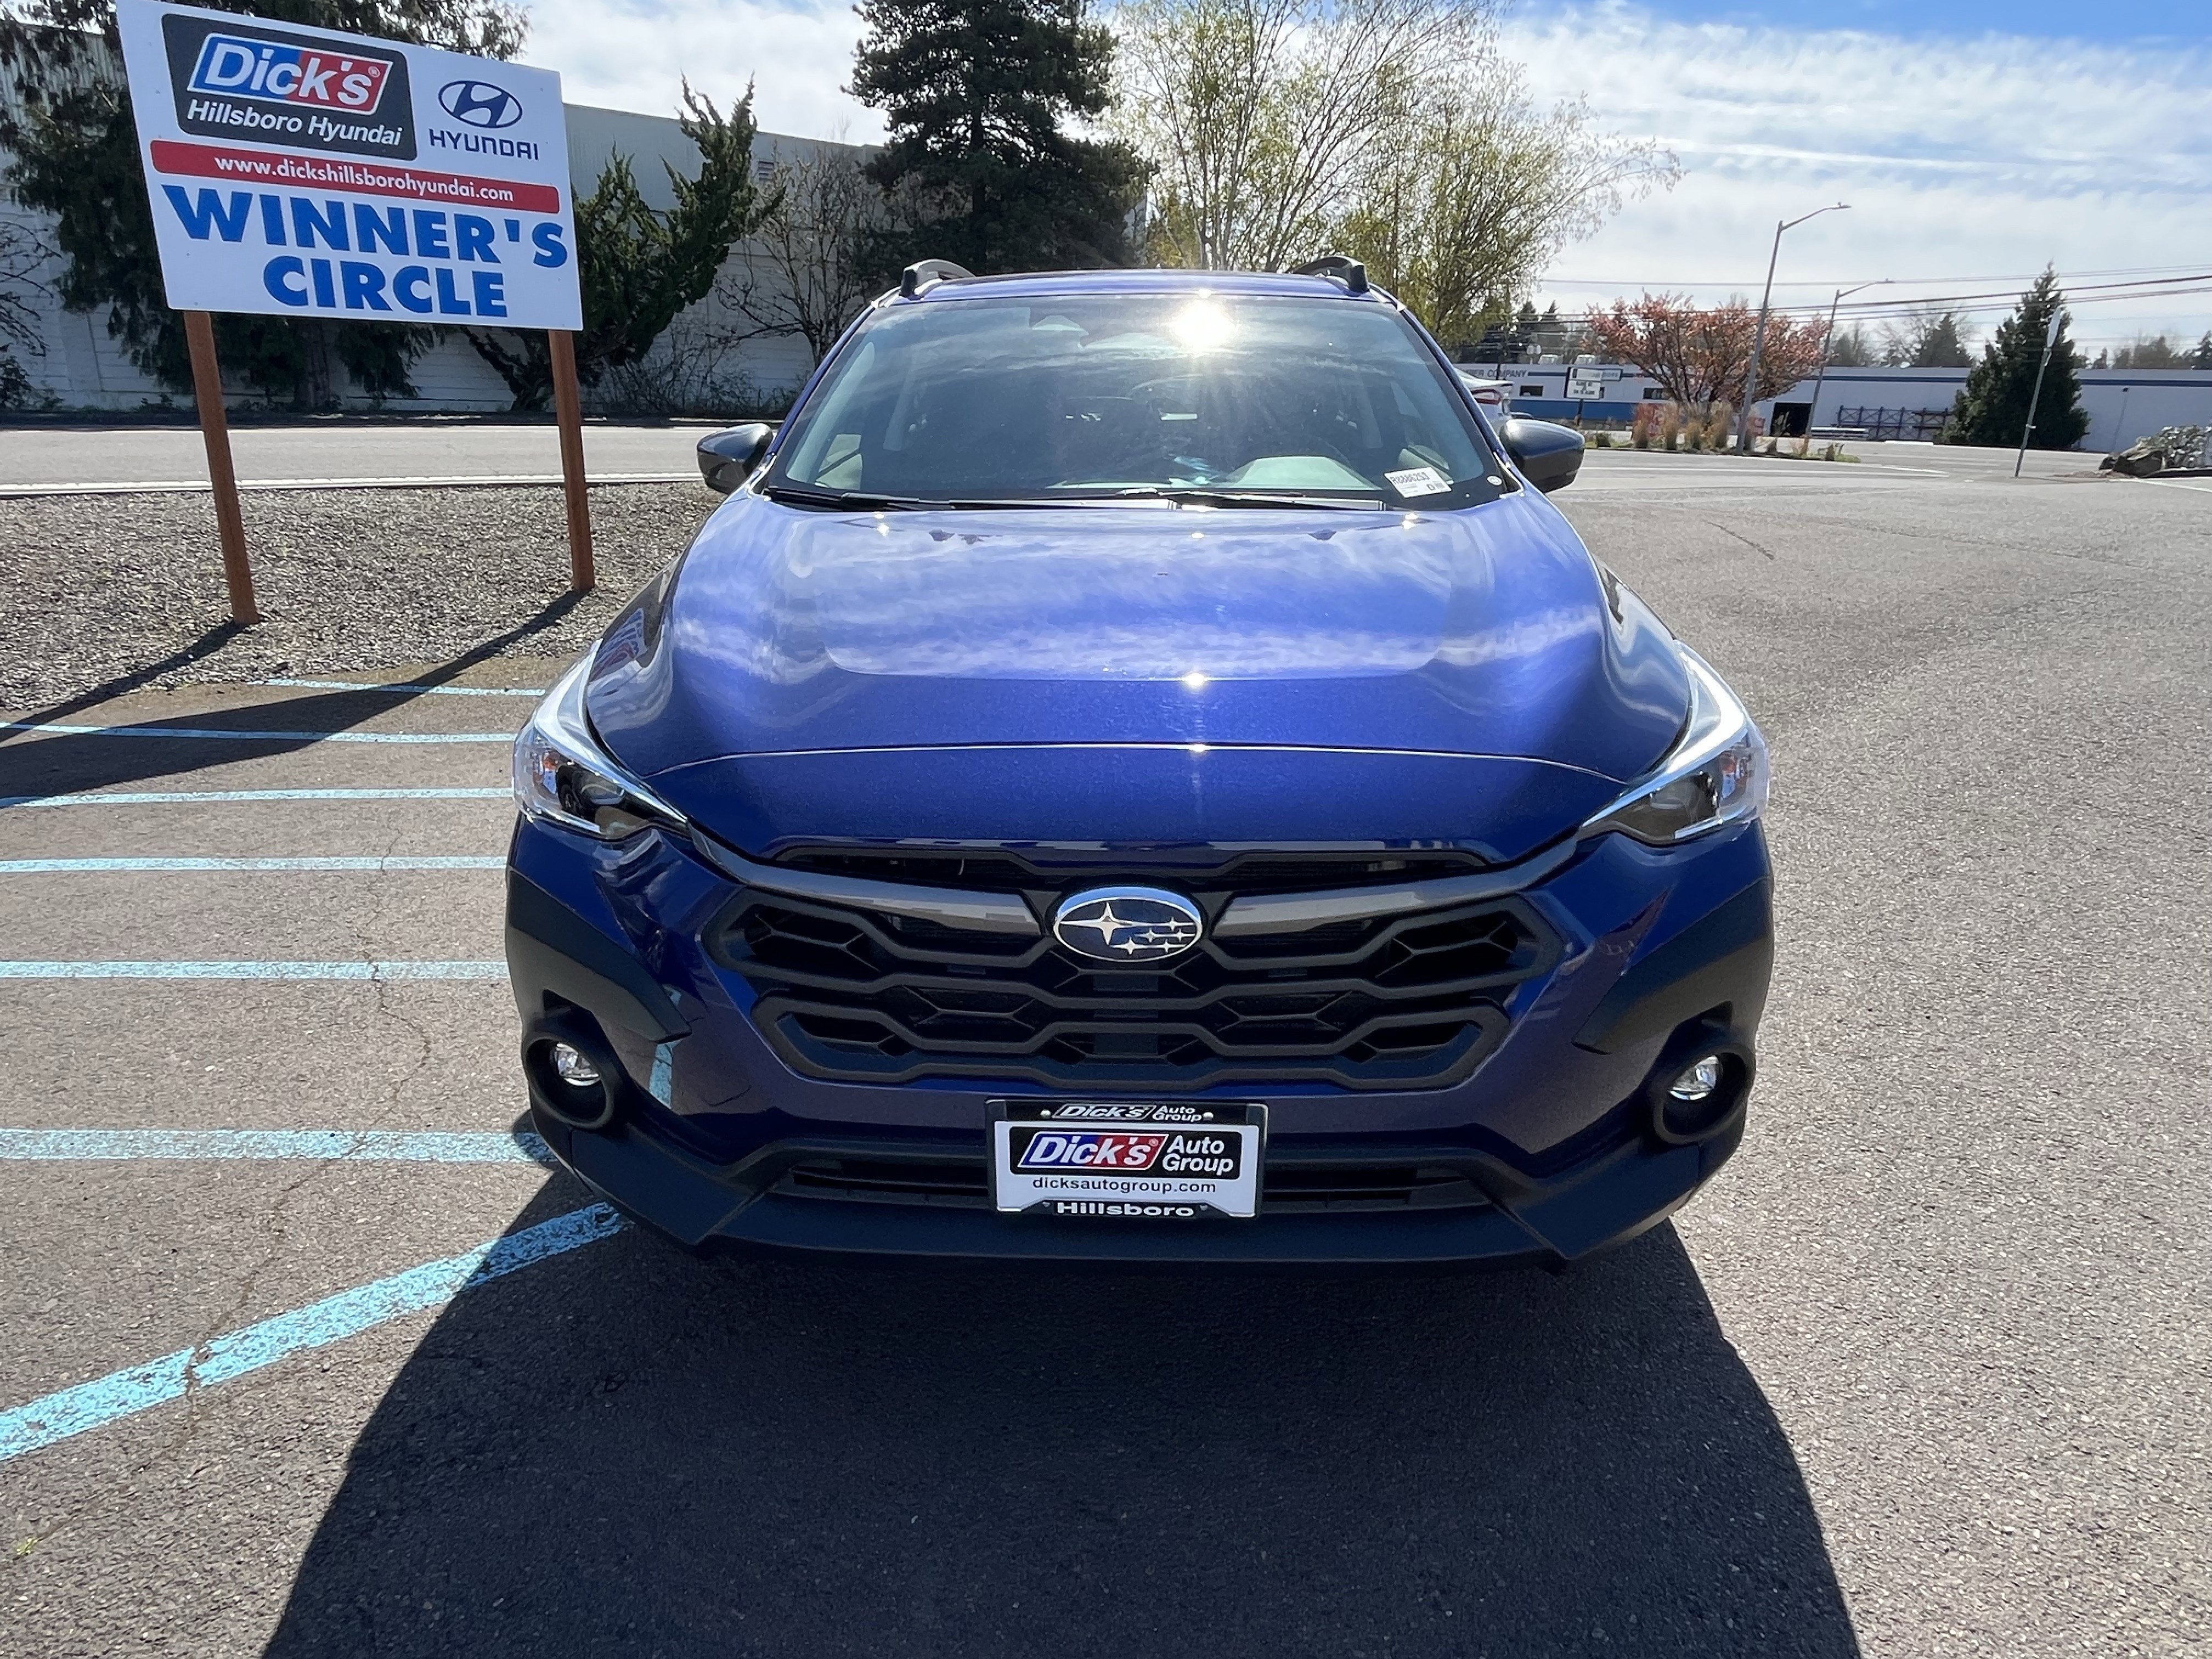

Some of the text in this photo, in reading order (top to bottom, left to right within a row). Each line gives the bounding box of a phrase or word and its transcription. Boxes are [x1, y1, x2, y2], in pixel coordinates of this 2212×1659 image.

[205, 42, 374, 106] Dick's
[187, 98, 404, 147] Hillsboro Hyundai
[429, 128, 539, 161] HYUNDAI
[214, 155, 514, 202] www.dickshillsborohyundai.com
[161, 184, 568, 268] WINNER'S
[263, 255, 508, 318] CIRCLE
[1059, 1106, 1195, 1118] Dick's Auto
[1153, 1113, 1204, 1122] Group
[1028, 1136, 1225, 1165] Dick's Auto
[1163, 1154, 1234, 1175] Group
[1032, 1177, 1217, 1194] dicksautogroup.com
[1057, 1202, 1194, 1217] Hillsboro
